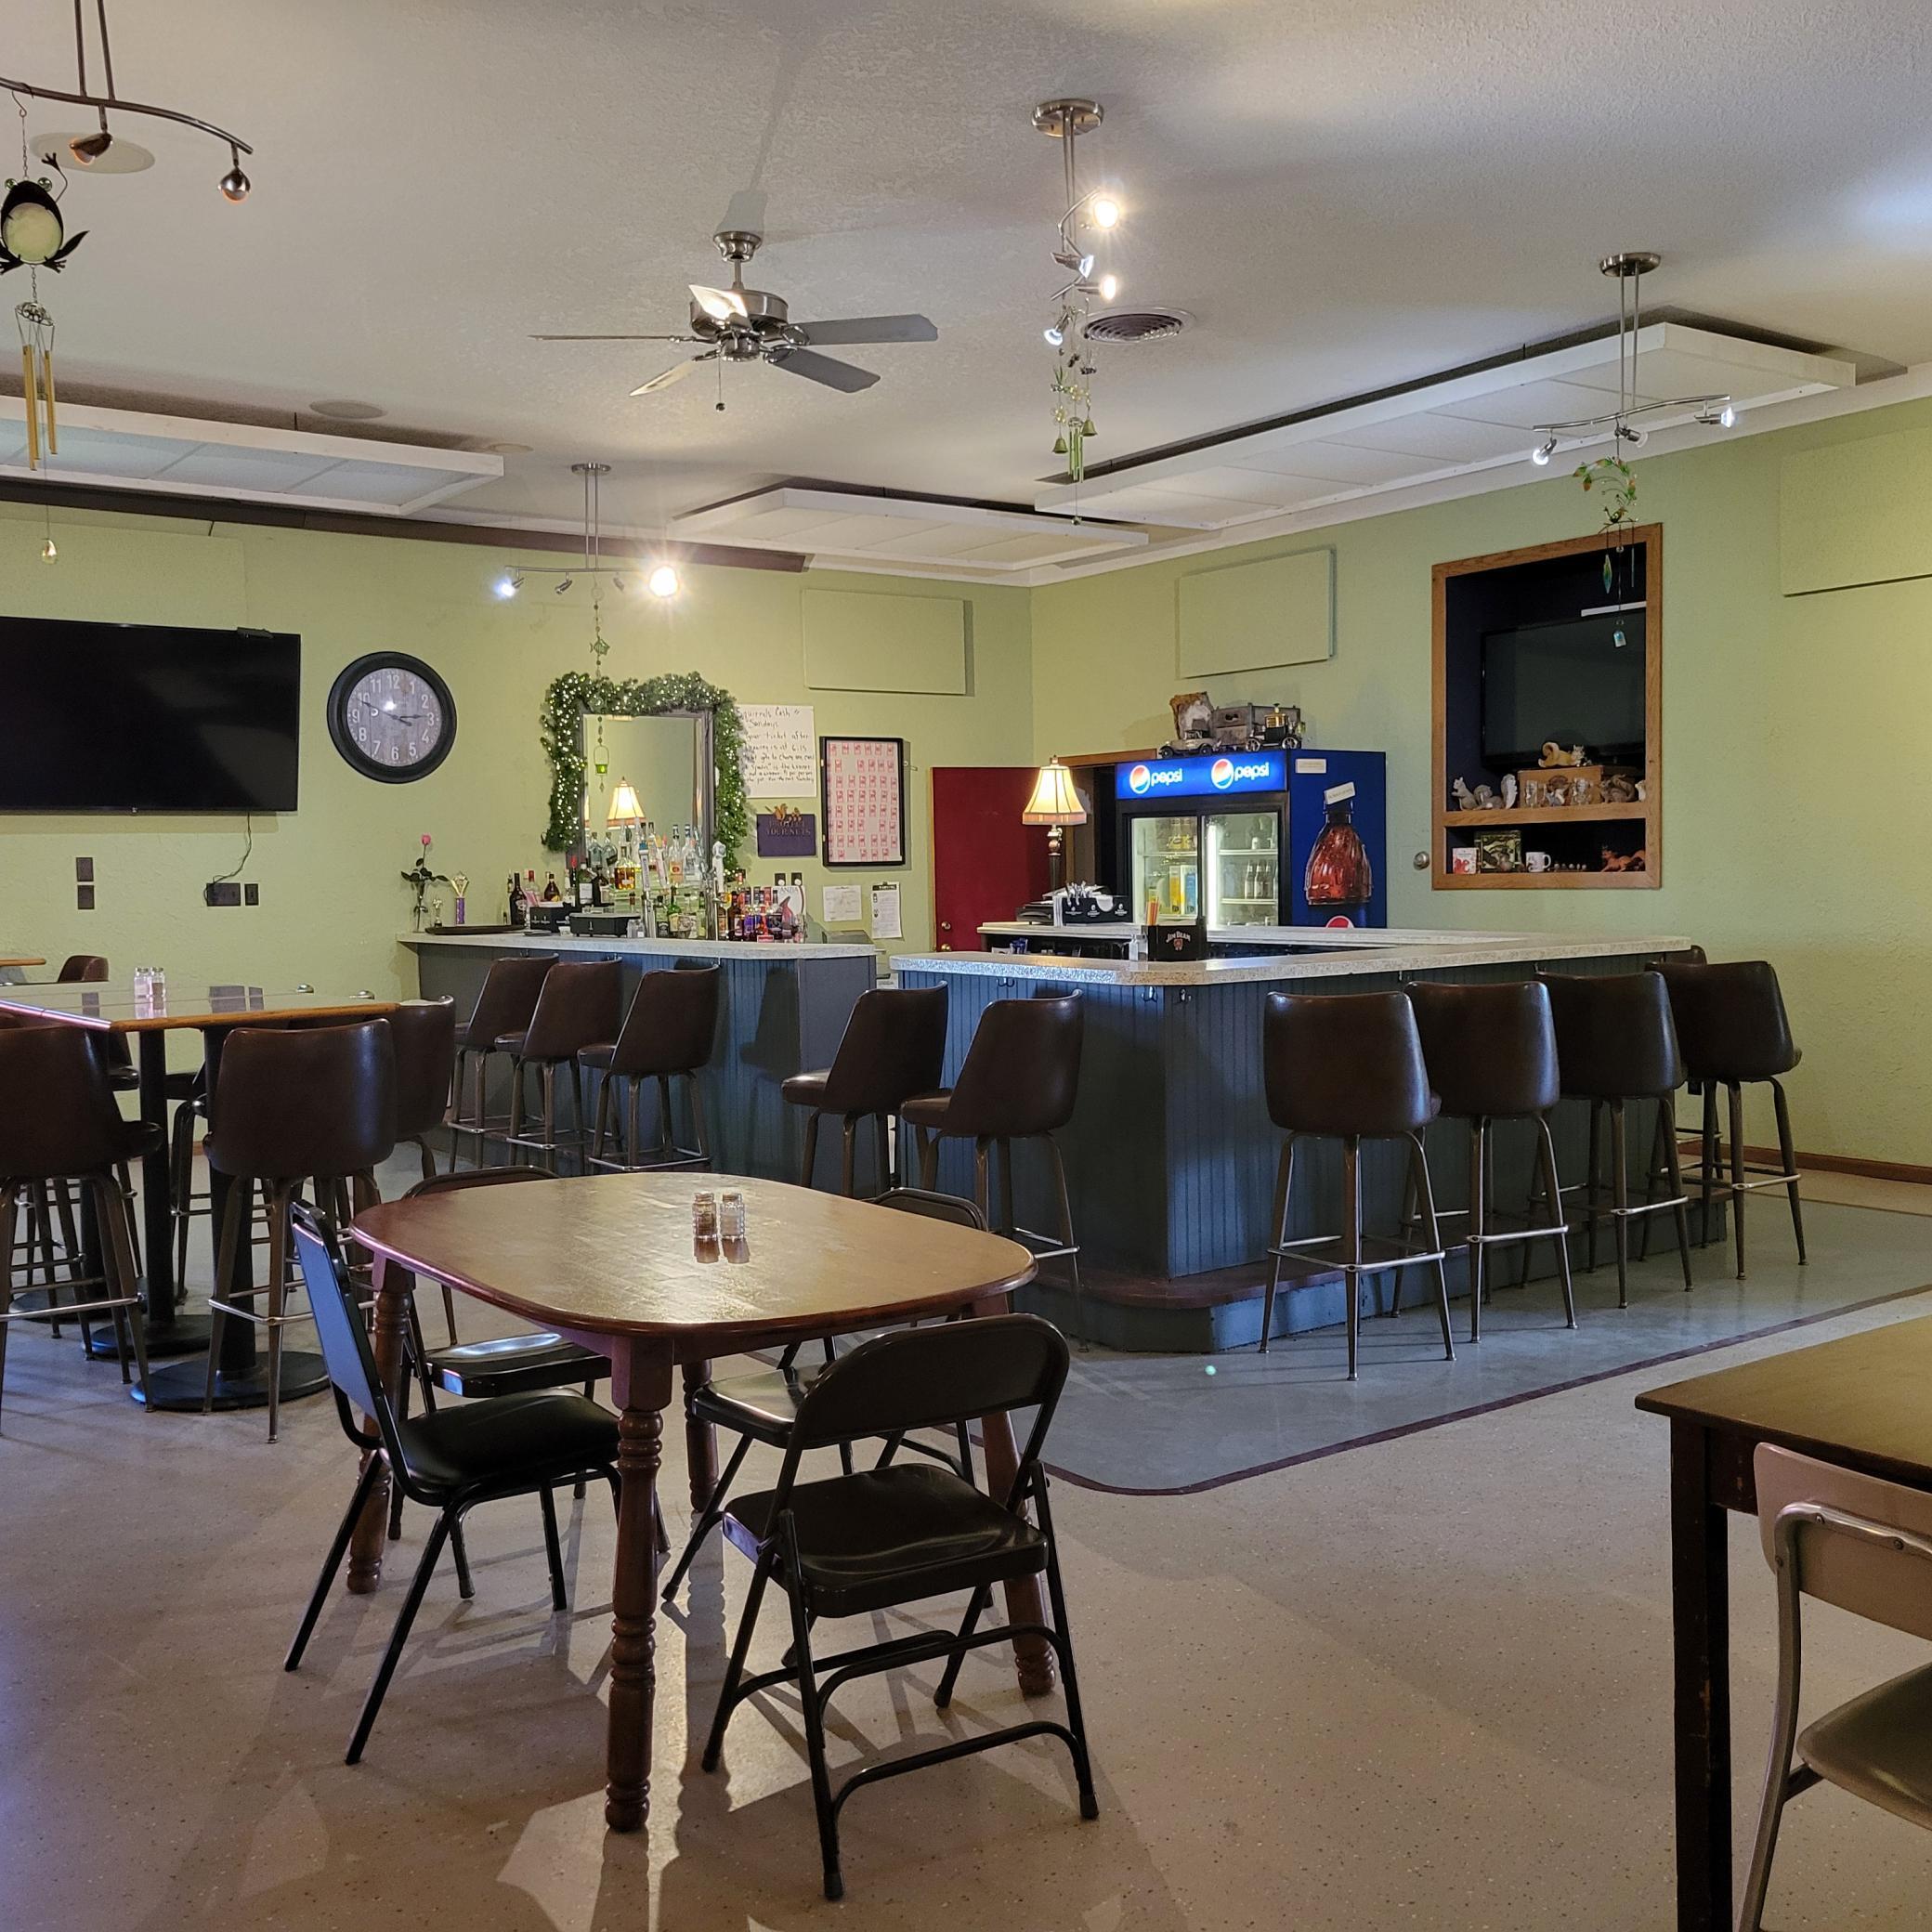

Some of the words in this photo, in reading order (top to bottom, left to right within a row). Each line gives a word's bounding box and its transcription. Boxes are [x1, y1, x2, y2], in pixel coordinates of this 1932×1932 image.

[371, 679, 382, 693] 11
[387, 674, 400, 689] 12
[410, 682, 415, 695] 1
[358, 692, 371, 707] 10
[422, 694, 429, 709] 2
[352, 709, 360, 724] 9
[427, 712, 435, 726] 3
[359, 727, 367, 741] 8
[422, 728, 430, 742] 4
[373, 740, 381, 754] 7
[391, 747, 398, 761] 6
[409, 743, 416, 757] 5
[1151, 768, 1183, 787] pepsi
[1234, 762, 1270, 781] pepsi
[1166, 933, 1177, 943] JIM
[1176, 930, 1192, 942] BEAM
